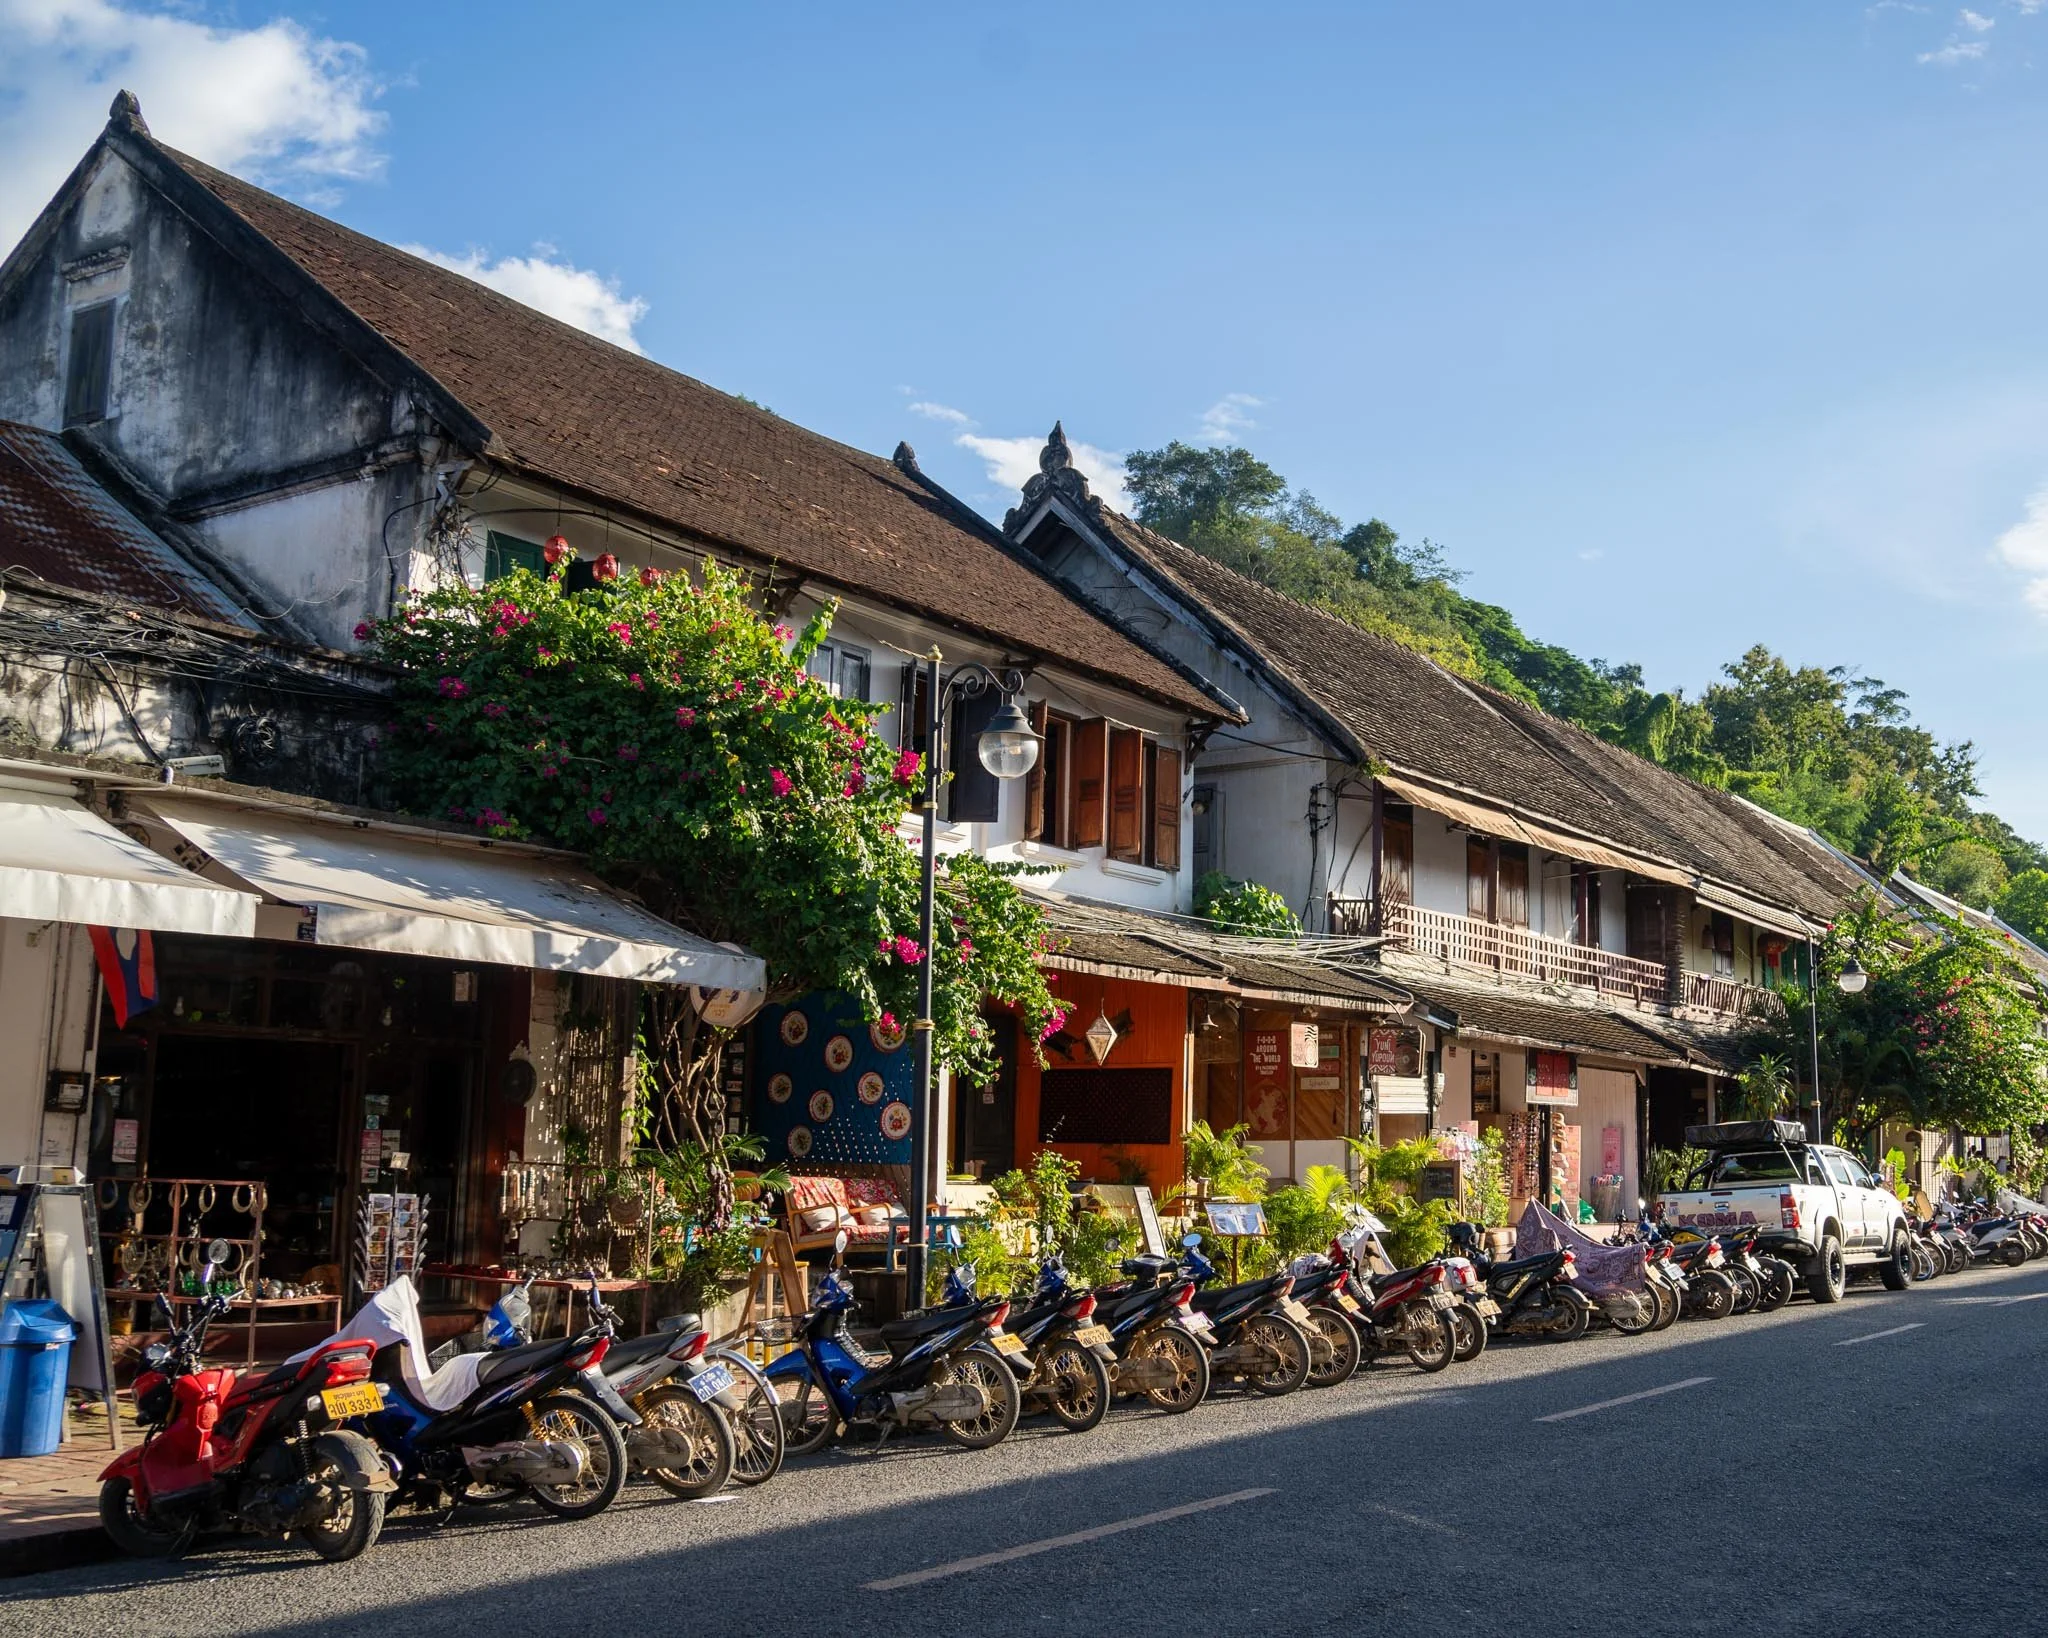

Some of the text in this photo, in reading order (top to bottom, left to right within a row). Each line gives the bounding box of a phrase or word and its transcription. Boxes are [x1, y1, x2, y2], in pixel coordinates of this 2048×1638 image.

[1256, 1044, 1277, 1053] AROUND
[1249, 1052, 1261, 1063] THE
[1262, 1053, 1281, 1063] WORLD
[1678, 1211, 1758, 1227] KOMA
[349, 1396, 380, 1412] 3331
